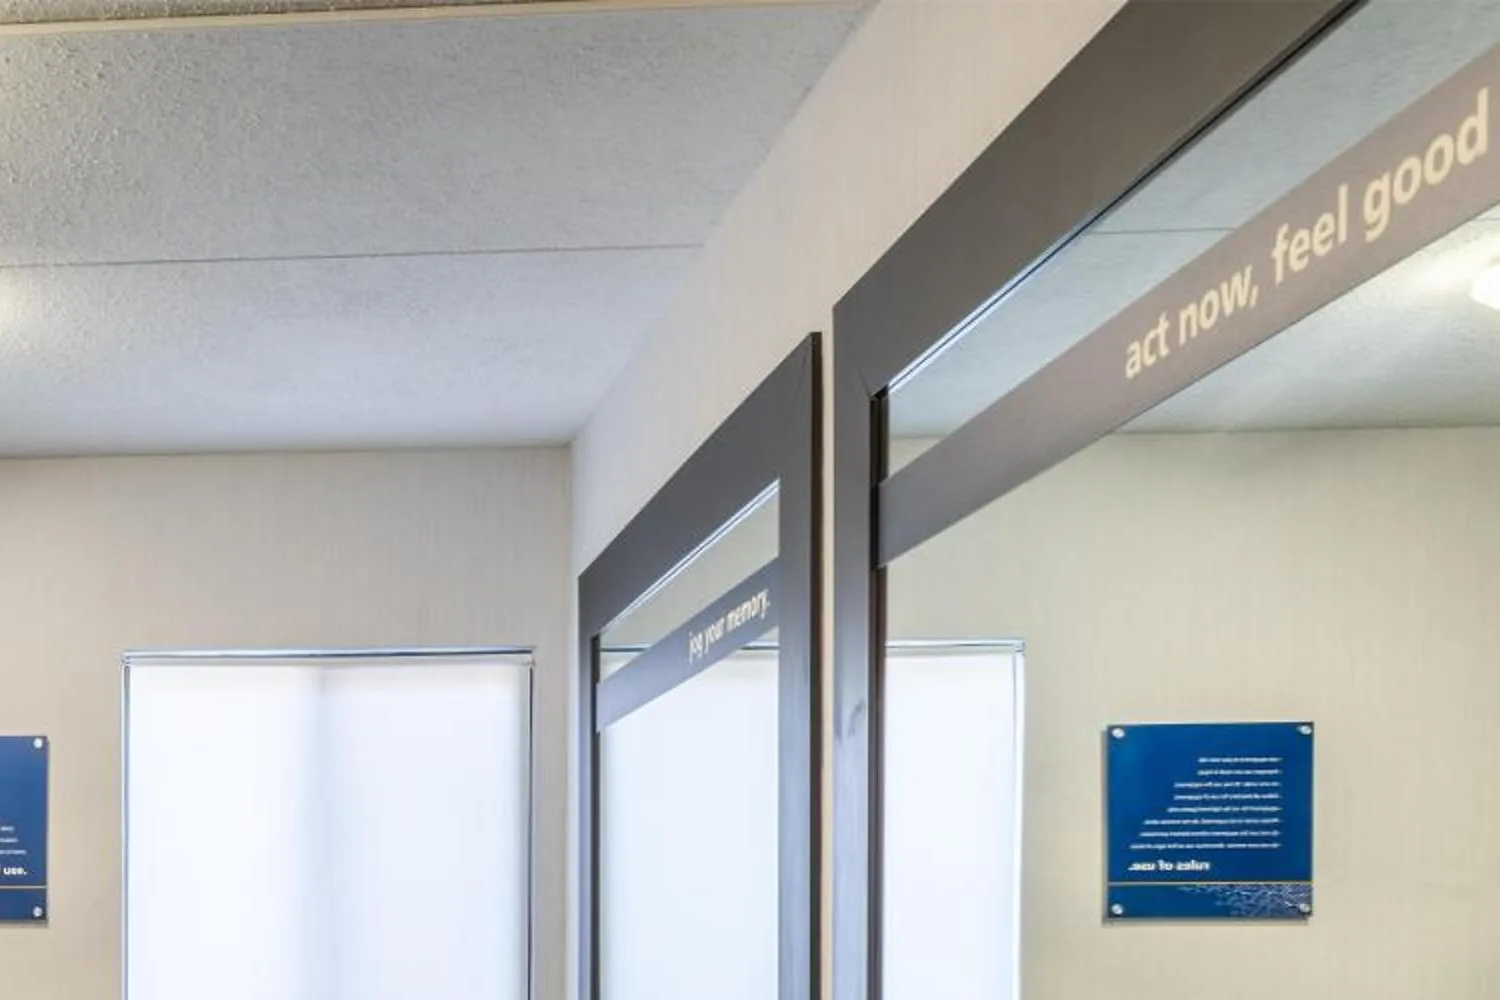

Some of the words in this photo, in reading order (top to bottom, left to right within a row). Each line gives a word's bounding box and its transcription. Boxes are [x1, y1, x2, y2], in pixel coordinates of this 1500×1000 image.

[1125, 311, 1170, 379] act
[1178, 264, 1260, 346] now,
[1270, 183, 1349, 288] feel
[1362, 86, 1490, 243] good
[3, 866, 28, 876] use.
